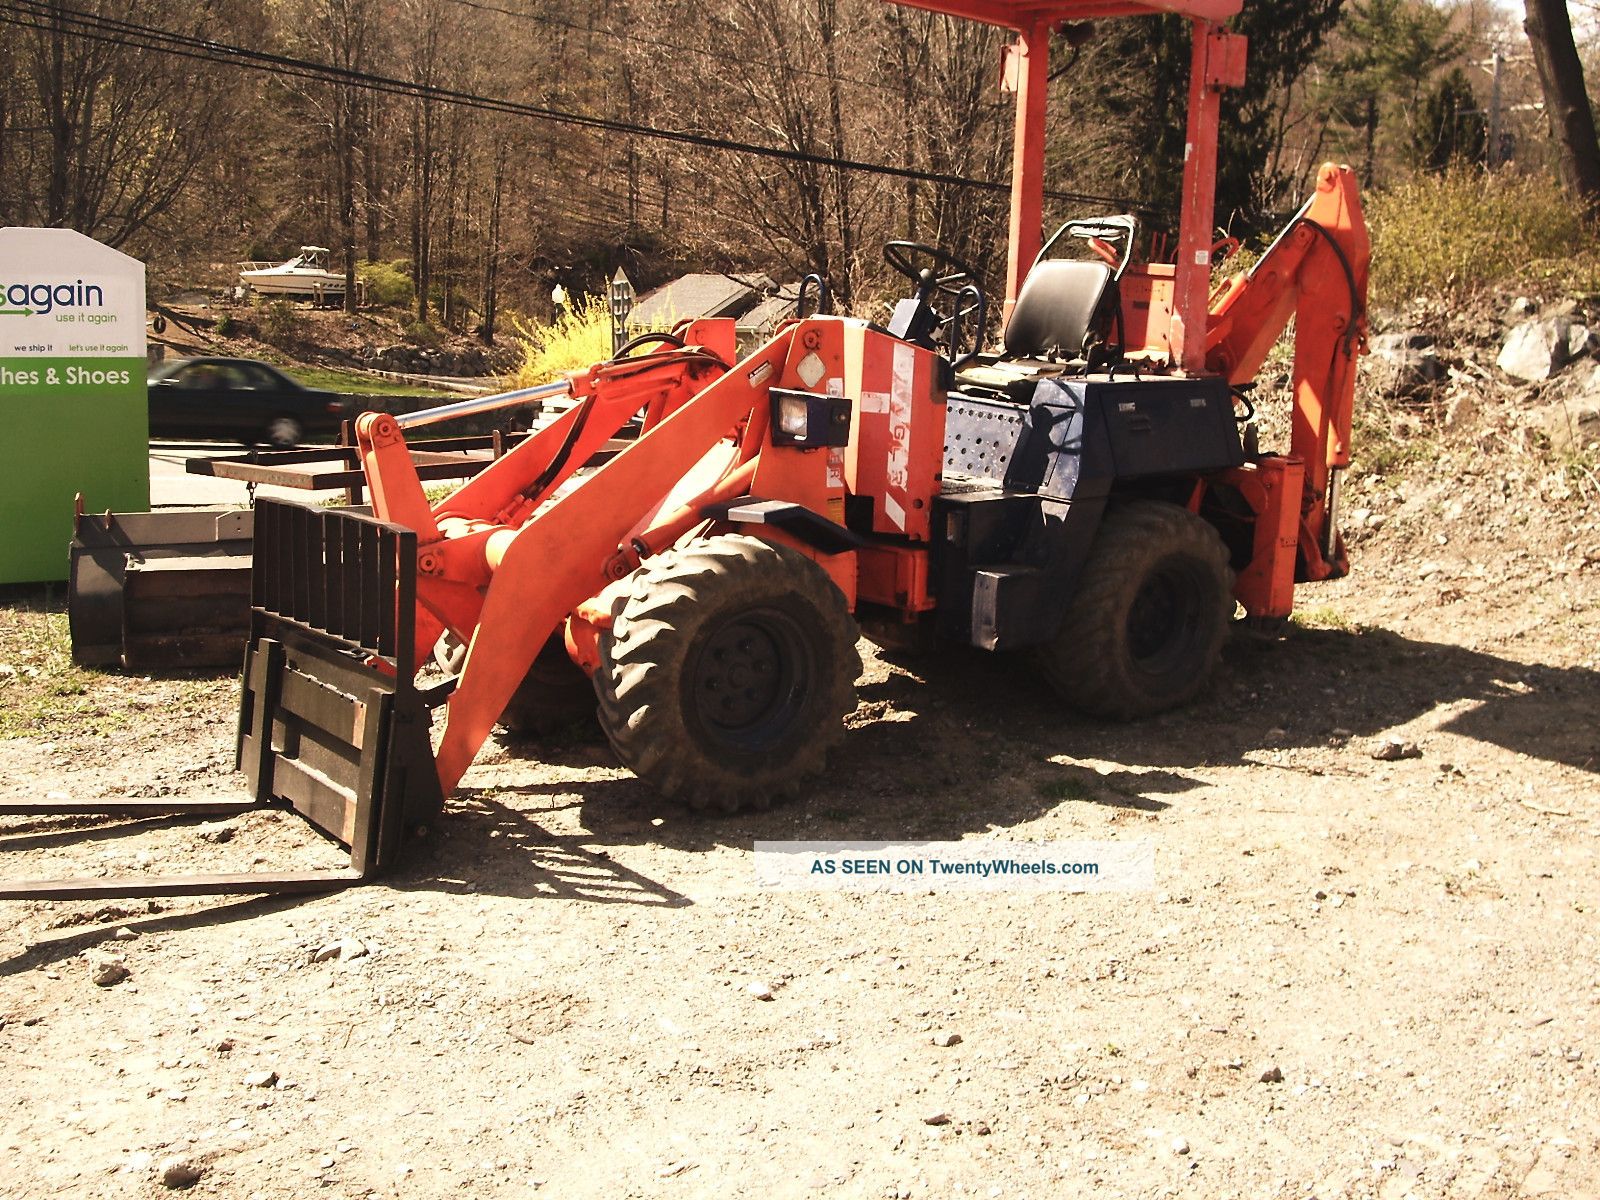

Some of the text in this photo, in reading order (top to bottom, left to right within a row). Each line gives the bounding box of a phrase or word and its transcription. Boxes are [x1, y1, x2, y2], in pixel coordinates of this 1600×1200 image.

[78, 314, 85, 322] it
[87, 314, 117, 325] again
[29, 344, 45, 353] ship
[47, 344, 53, 352] it
[100, 344, 105, 352] it
[106, 344, 129, 353] again
[45, 367, 61, 385] &
[66, 366, 130, 385] Shoes
